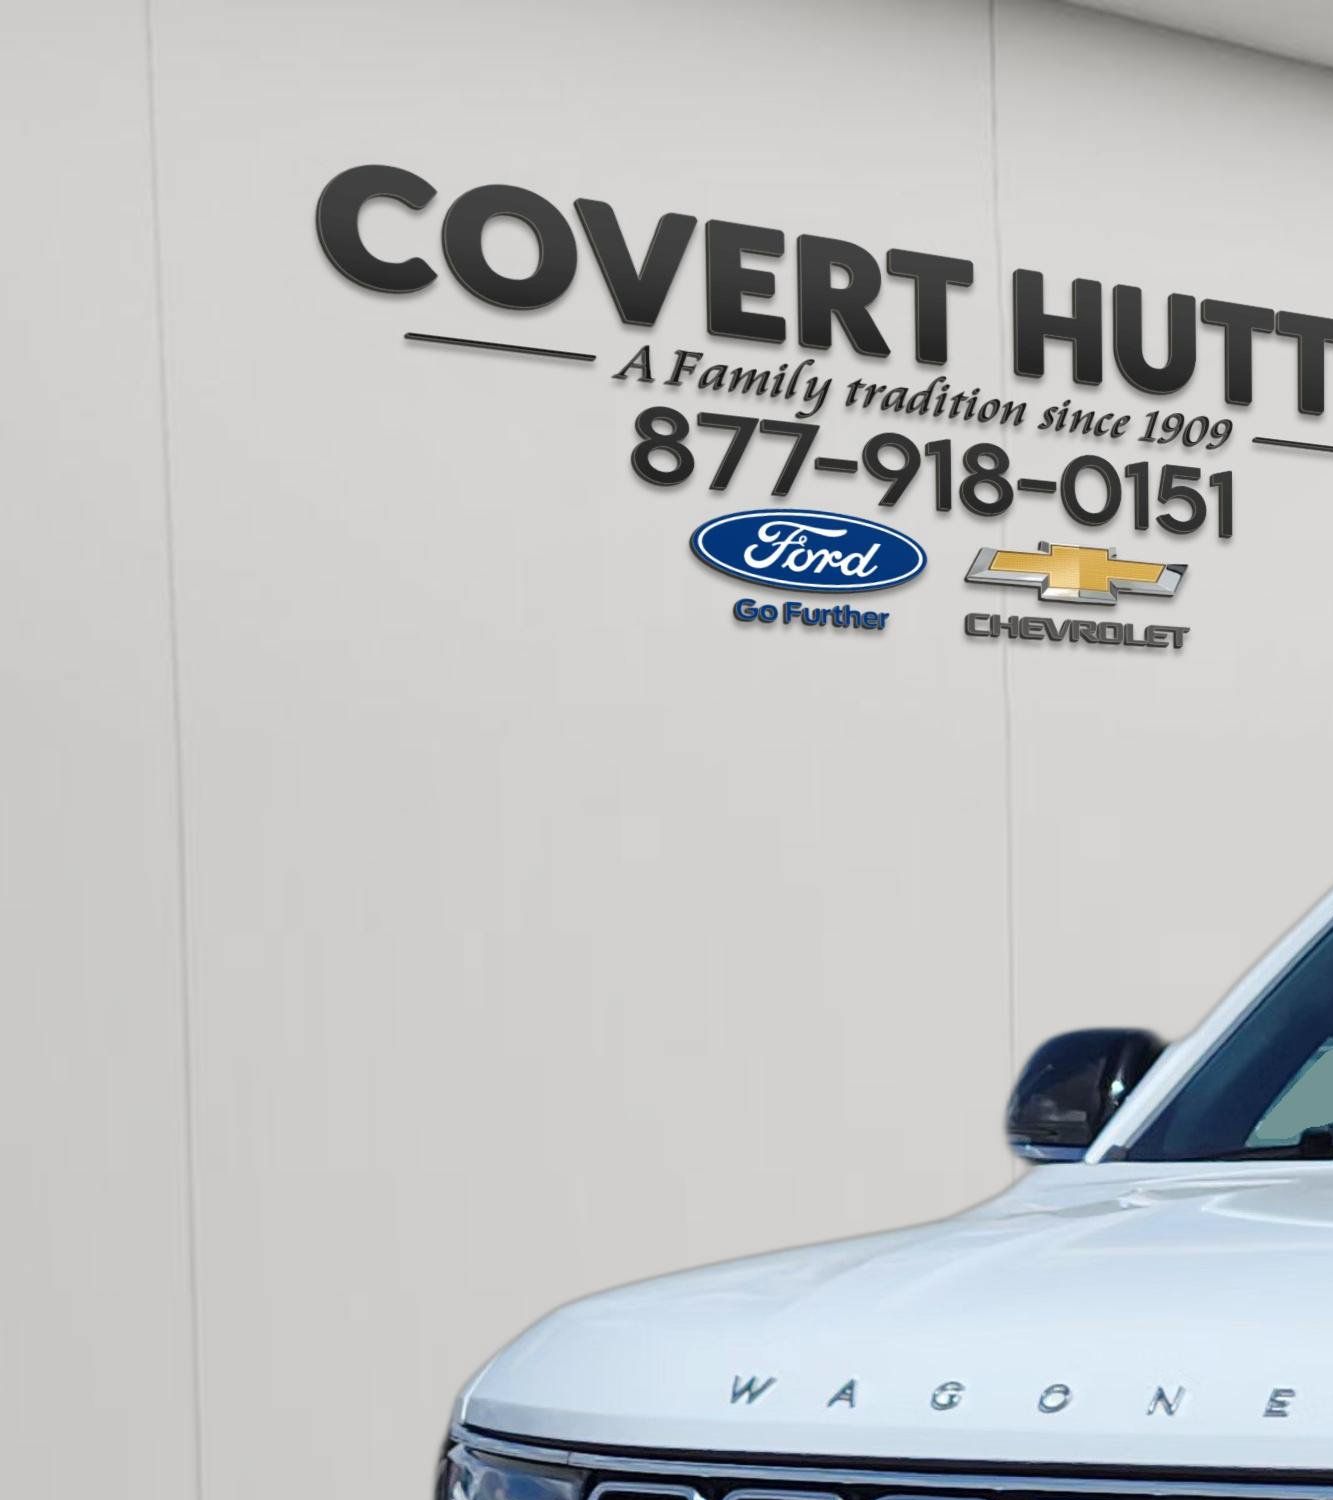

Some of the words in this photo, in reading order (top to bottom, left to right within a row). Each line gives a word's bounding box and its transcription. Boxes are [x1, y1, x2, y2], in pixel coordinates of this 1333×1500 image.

[314, 164, 975, 364] COVERT
[613, 345, 655, 383] A
[666, 350, 832, 420] Family
[844, 374, 1024, 427] tradition
[1037, 400, 1130, 439] since
[1139, 410, 1233, 450] 1909
[630, 405, 1234, 538] 877-918-0151
[742, 519, 882, 579] Ford
[734, 599, 778, 624] Go
[782, 602, 890, 631] Further
[964, 612, 1190, 649] CHEVROLET
